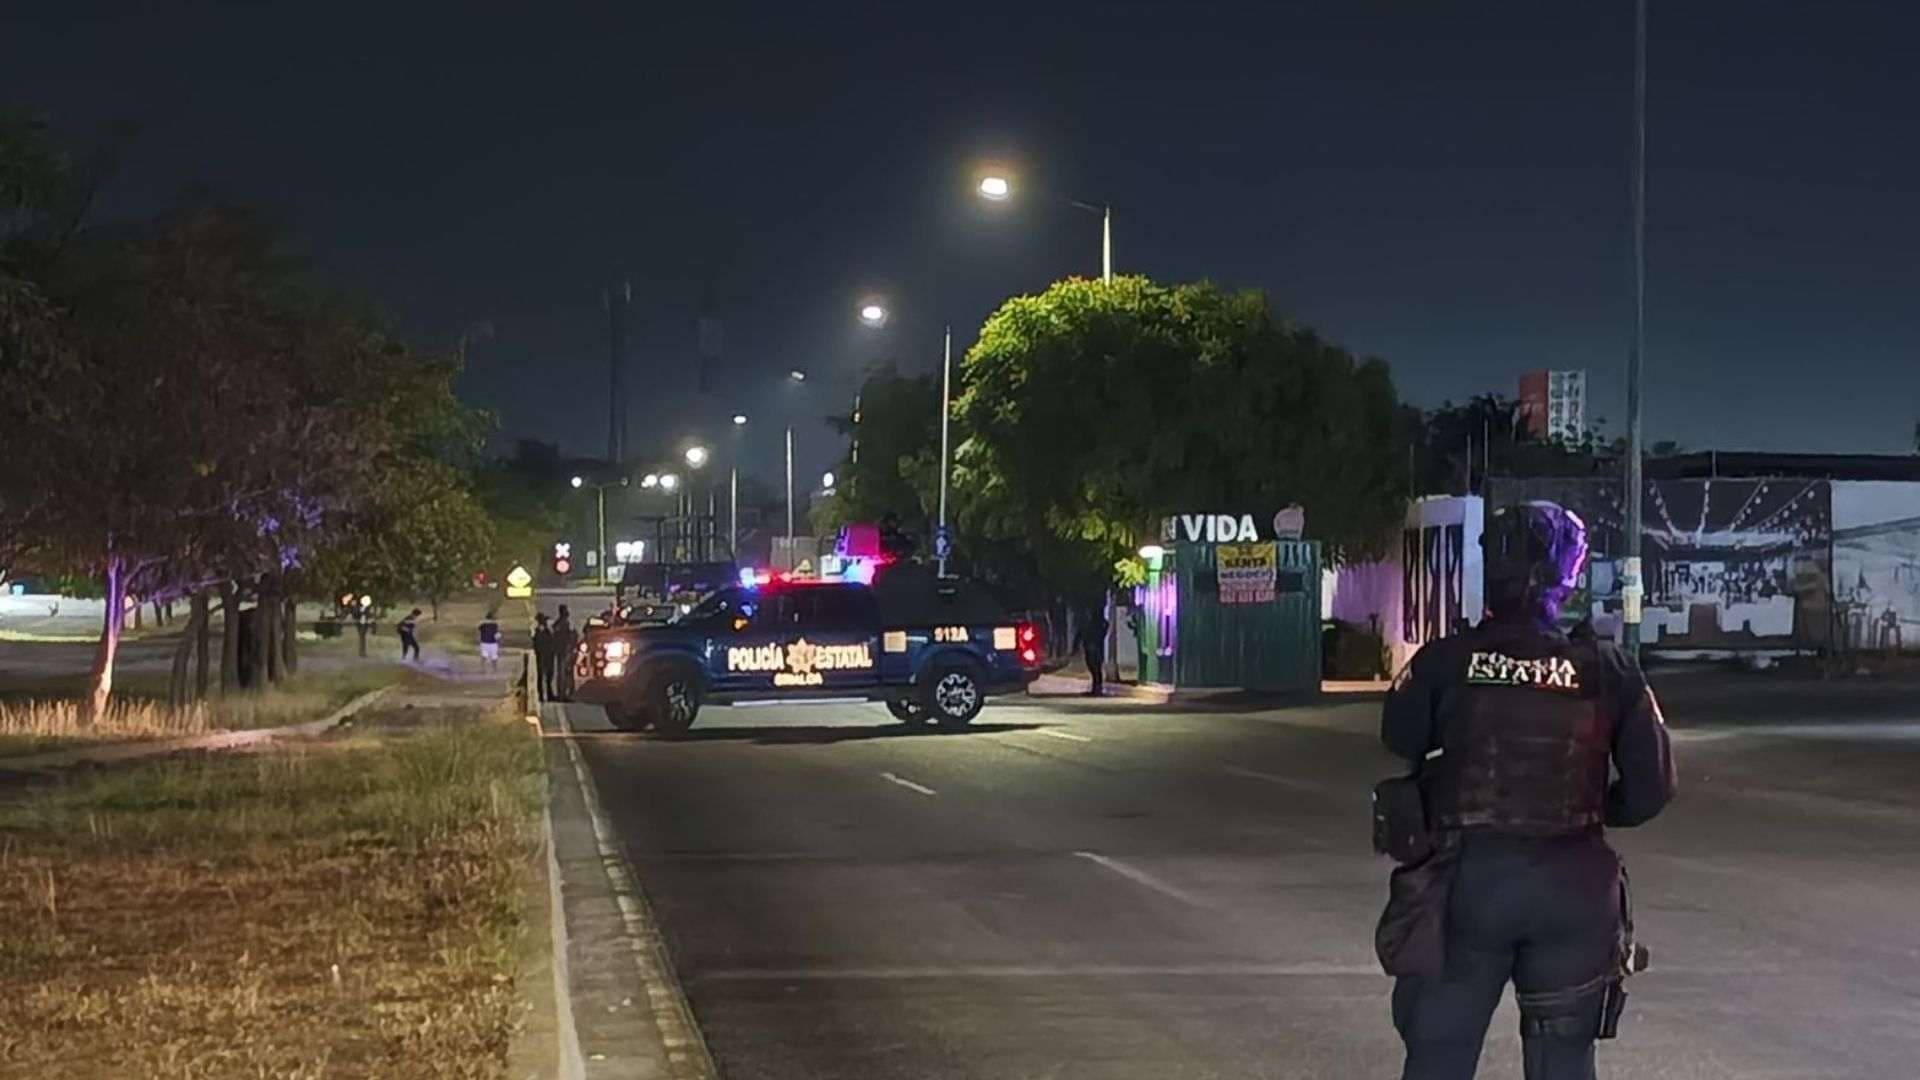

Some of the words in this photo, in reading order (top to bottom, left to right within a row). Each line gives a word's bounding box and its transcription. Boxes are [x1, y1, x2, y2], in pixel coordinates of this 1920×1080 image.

[1181, 514, 1259, 543] VIDA
[728, 642, 785, 671] POLICÍA
[815, 644, 873, 669] ESTATAL
